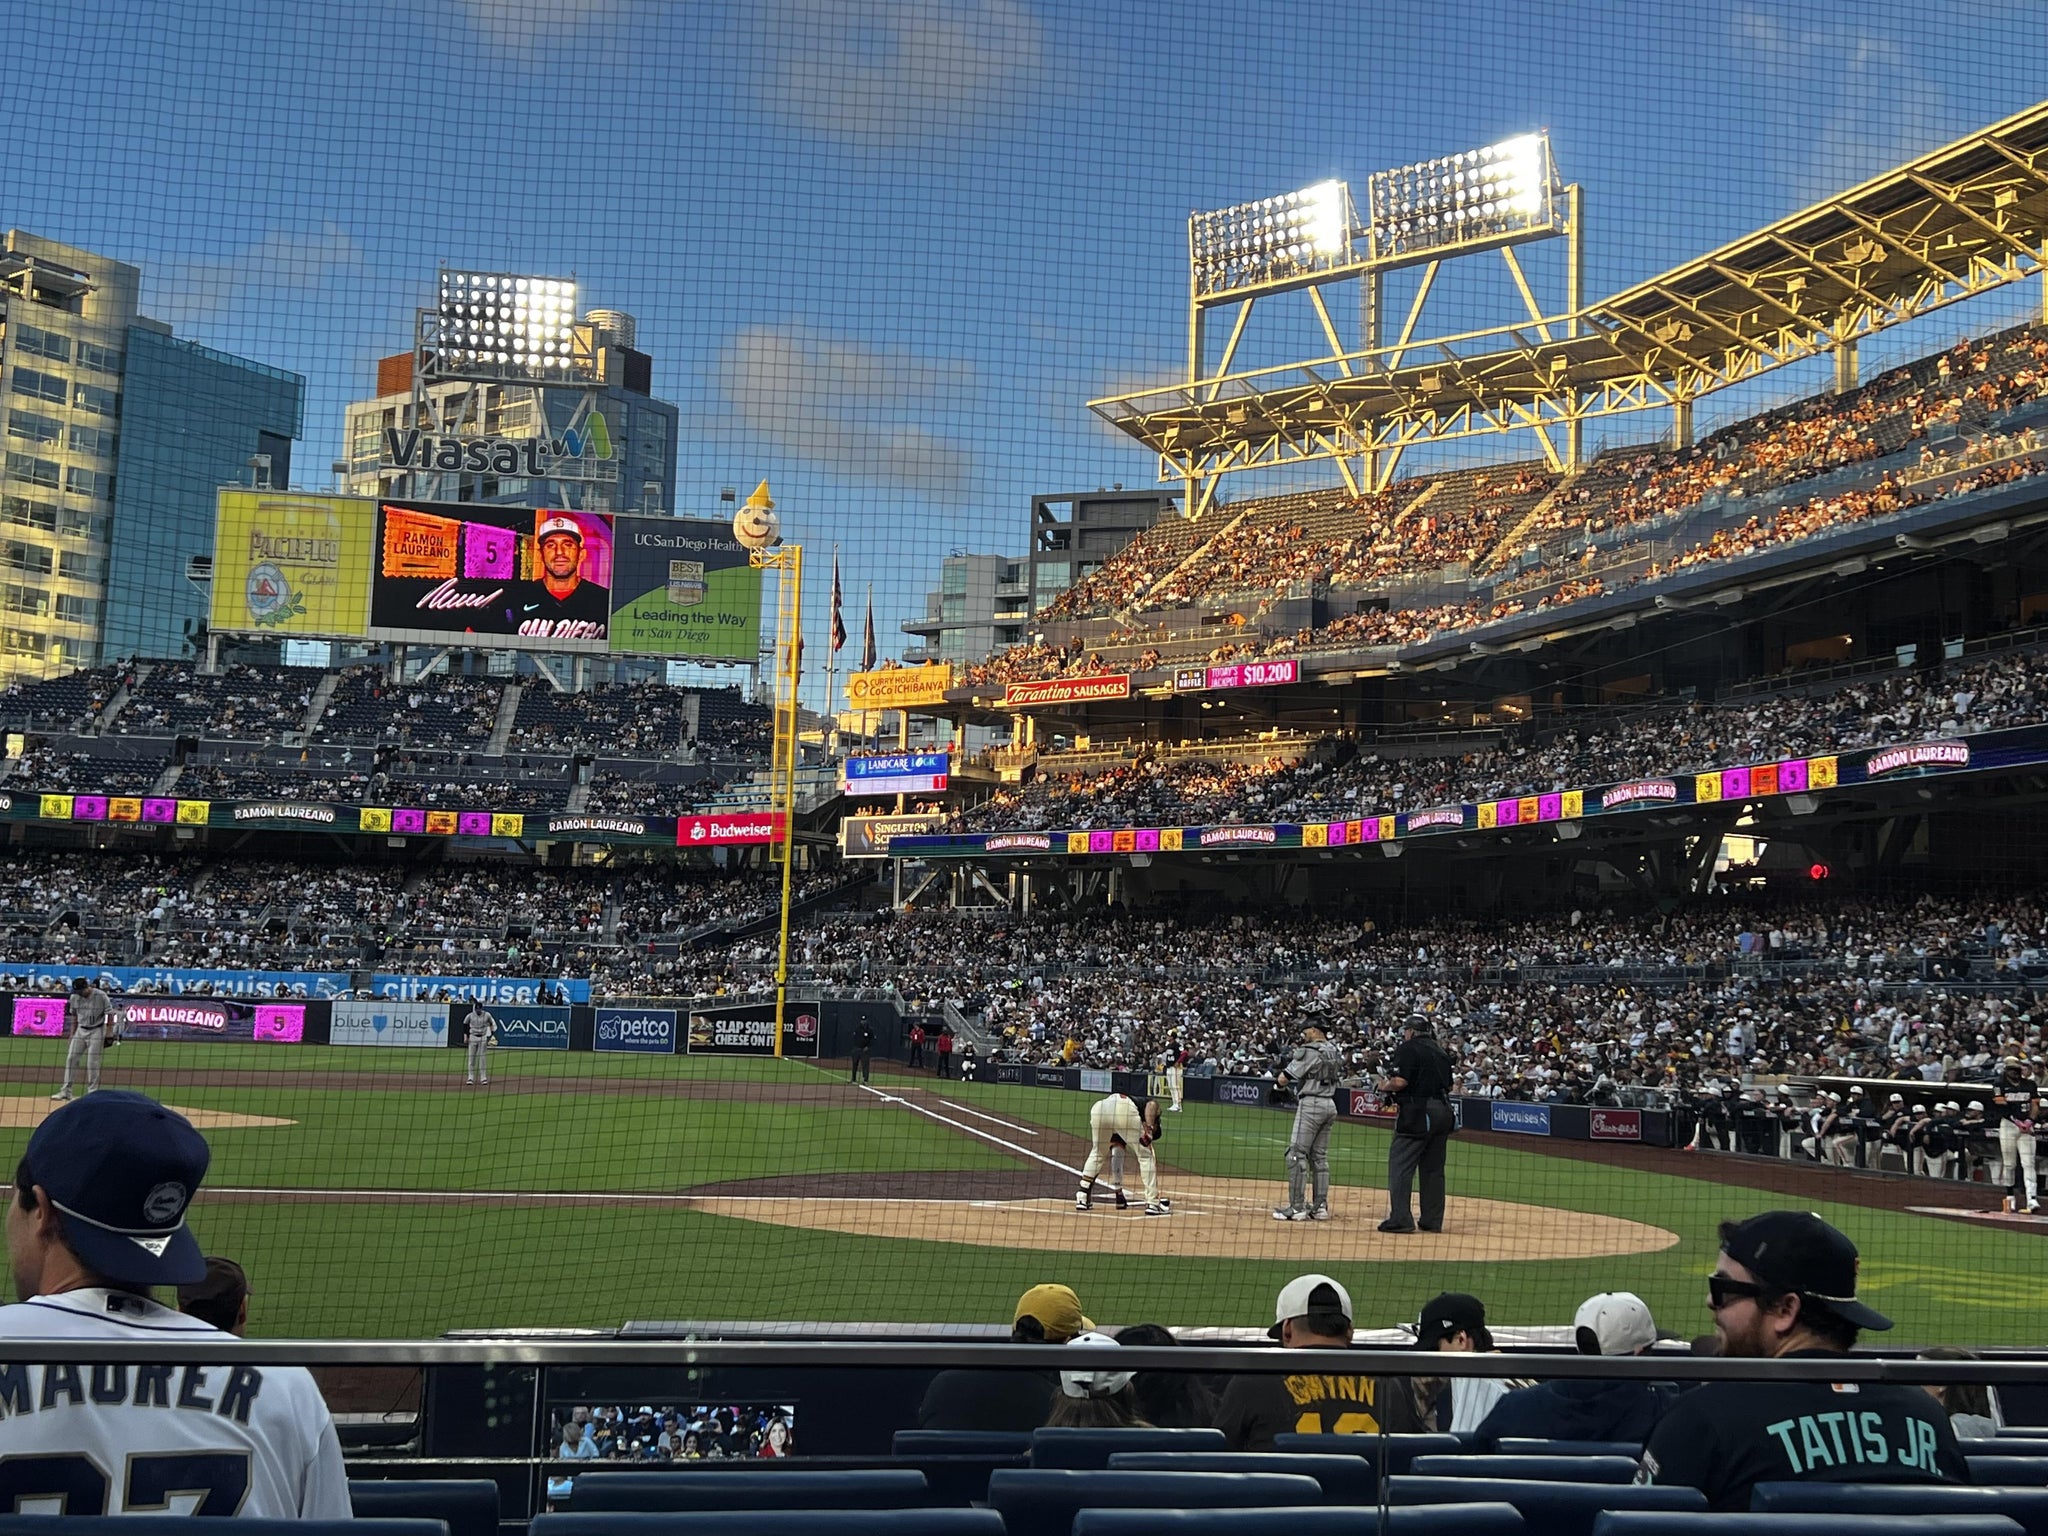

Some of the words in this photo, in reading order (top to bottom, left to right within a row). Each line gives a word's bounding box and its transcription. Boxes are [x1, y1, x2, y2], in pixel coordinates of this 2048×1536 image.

[385, 426, 546, 476] Viasat
[634, 533, 653, 546] UC
[653, 534, 674, 548] San
[676, 536, 707, 552] Diego
[708, 538, 743, 552] Health
[393, 543, 450, 559] LAUREANO
[486, 541, 498, 564] 5
[671, 562, 701, 573] BEST
[633, 607, 689, 625] Leading
[691, 611, 714, 624] the
[718, 613, 747, 628] Way
[518, 619, 554, 638] SAN
[632, 625, 644, 637] in
[648, 627, 672, 639] San
[677, 629, 711, 643] Diego
[1211, 666, 1238, 677] TODAY'S
[1244, 662, 1292, 685] $10,200
[870, 677, 894, 687] CURRY
[895, 674, 920, 685] HOUSE
[870, 685, 893, 696] CoCo
[894, 681, 944, 694] ICHIBANYA
[1179, 677, 1202, 688] RAFFLE
[1211, 676, 1238, 687] JACKPOT
[1008, 683, 1072, 703] Tarantino
[1073, 683, 1125, 698] SAUSAGES
[1910, 746, 1968, 762] LAUREANO
[868, 758, 909, 770] LANDCARE
[911, 757, 938, 768] LOGIC
[846, 782, 853, 792] K
[1633, 784, 1677, 799] LAUREANO
[277, 808, 333, 823] LAUREANO
[590, 819, 644, 834] LAUREANO
[710, 822, 772, 838] Budweiser
[1013, 836, 1050, 849] LAUREANO
[1232, 829, 1275, 842] LAUREANO
[34, 1010, 46, 1025] 5
[151, 1007, 225, 1028] LAUREANO
[273, 1016, 285, 1032] 5
[334, 1014, 371, 1028] blue
[393, 1015, 429, 1030] blue
[499, 1018, 568, 1034] VANDA
[620, 1015, 670, 1040] petco
[715, 1020, 744, 1035] SLAP
[745, 1020, 777, 1035] SOME
[714, 1033, 750, 1046] CHEESE
[750, 1034, 765, 1047] ON
[765, 1034, 777, 1047] IT
[1231, 1082, 1260, 1100] petco
[1493, 1108, 1540, 1126] citycruises
[1766, 1411, 1889, 1474] TATIS
